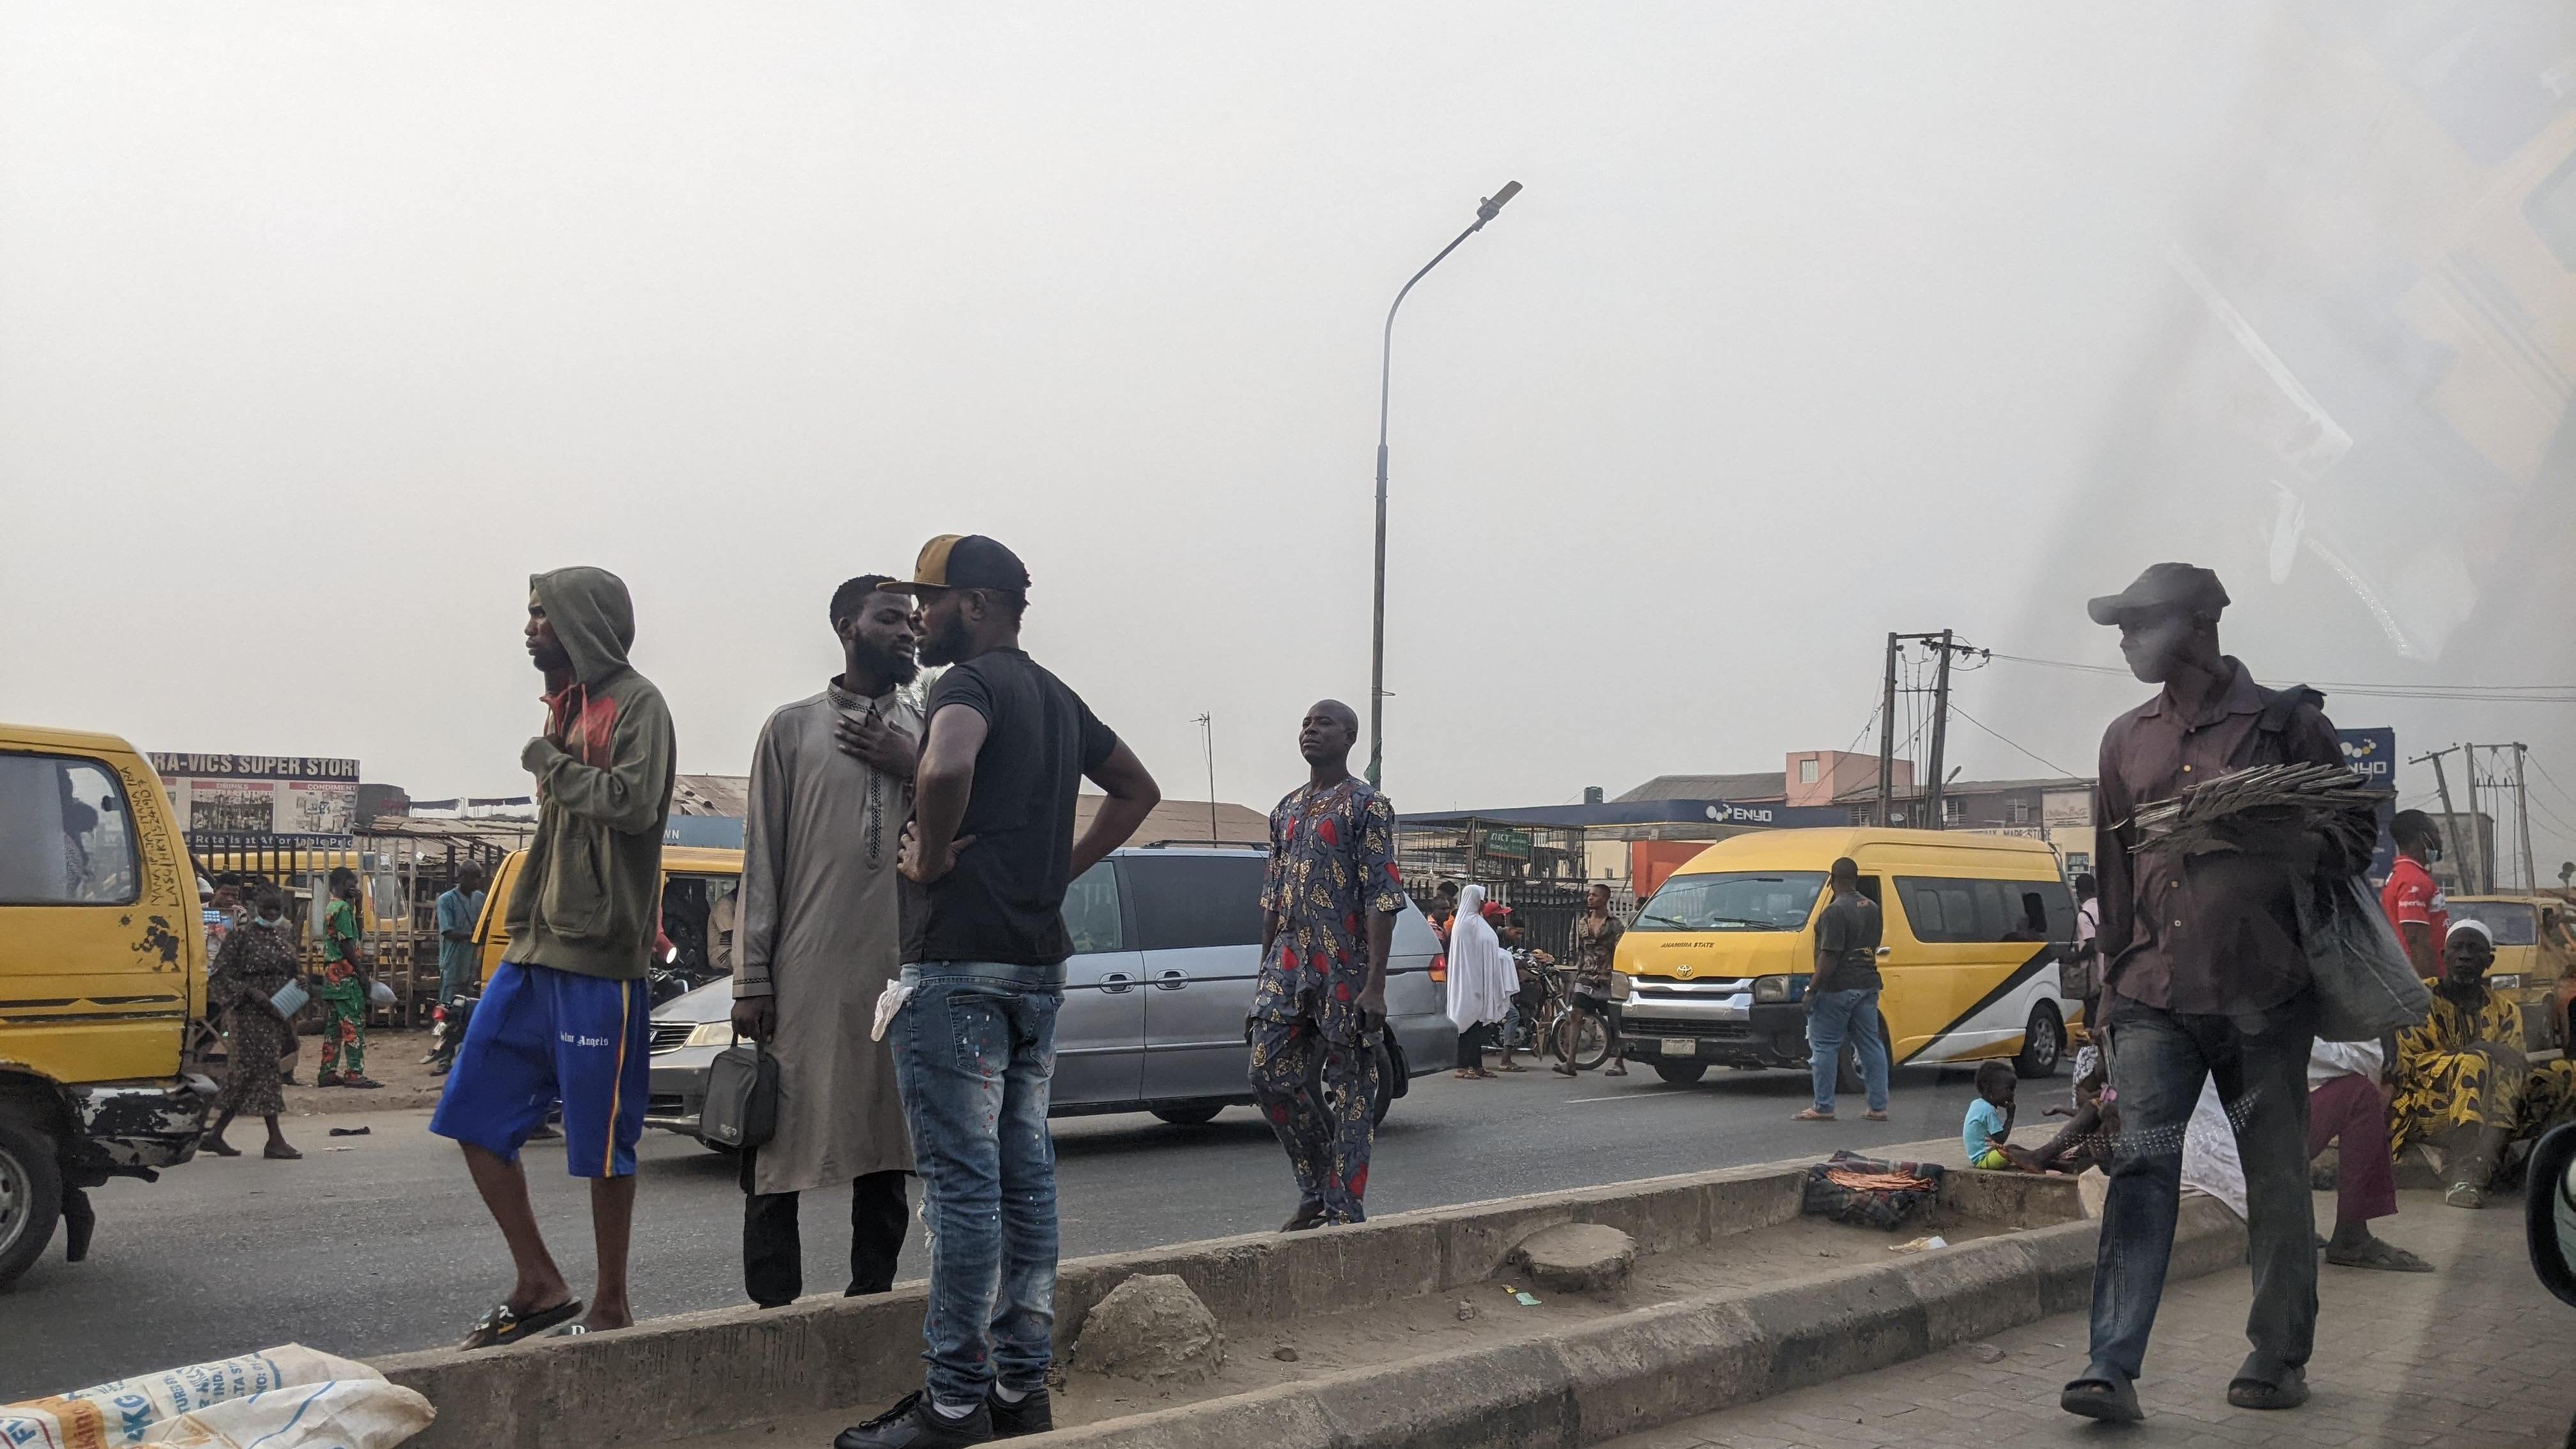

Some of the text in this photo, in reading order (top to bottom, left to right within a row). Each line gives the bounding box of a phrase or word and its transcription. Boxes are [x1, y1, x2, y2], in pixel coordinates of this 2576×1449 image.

[150, 753, 233, 774] RA-VICS
[238, 756, 300, 775] SUPER
[1733, 808, 1772, 822] ENYO
[261, 836, 326, 845] Afordable
[577, 1035, 609, 1048] Angels
